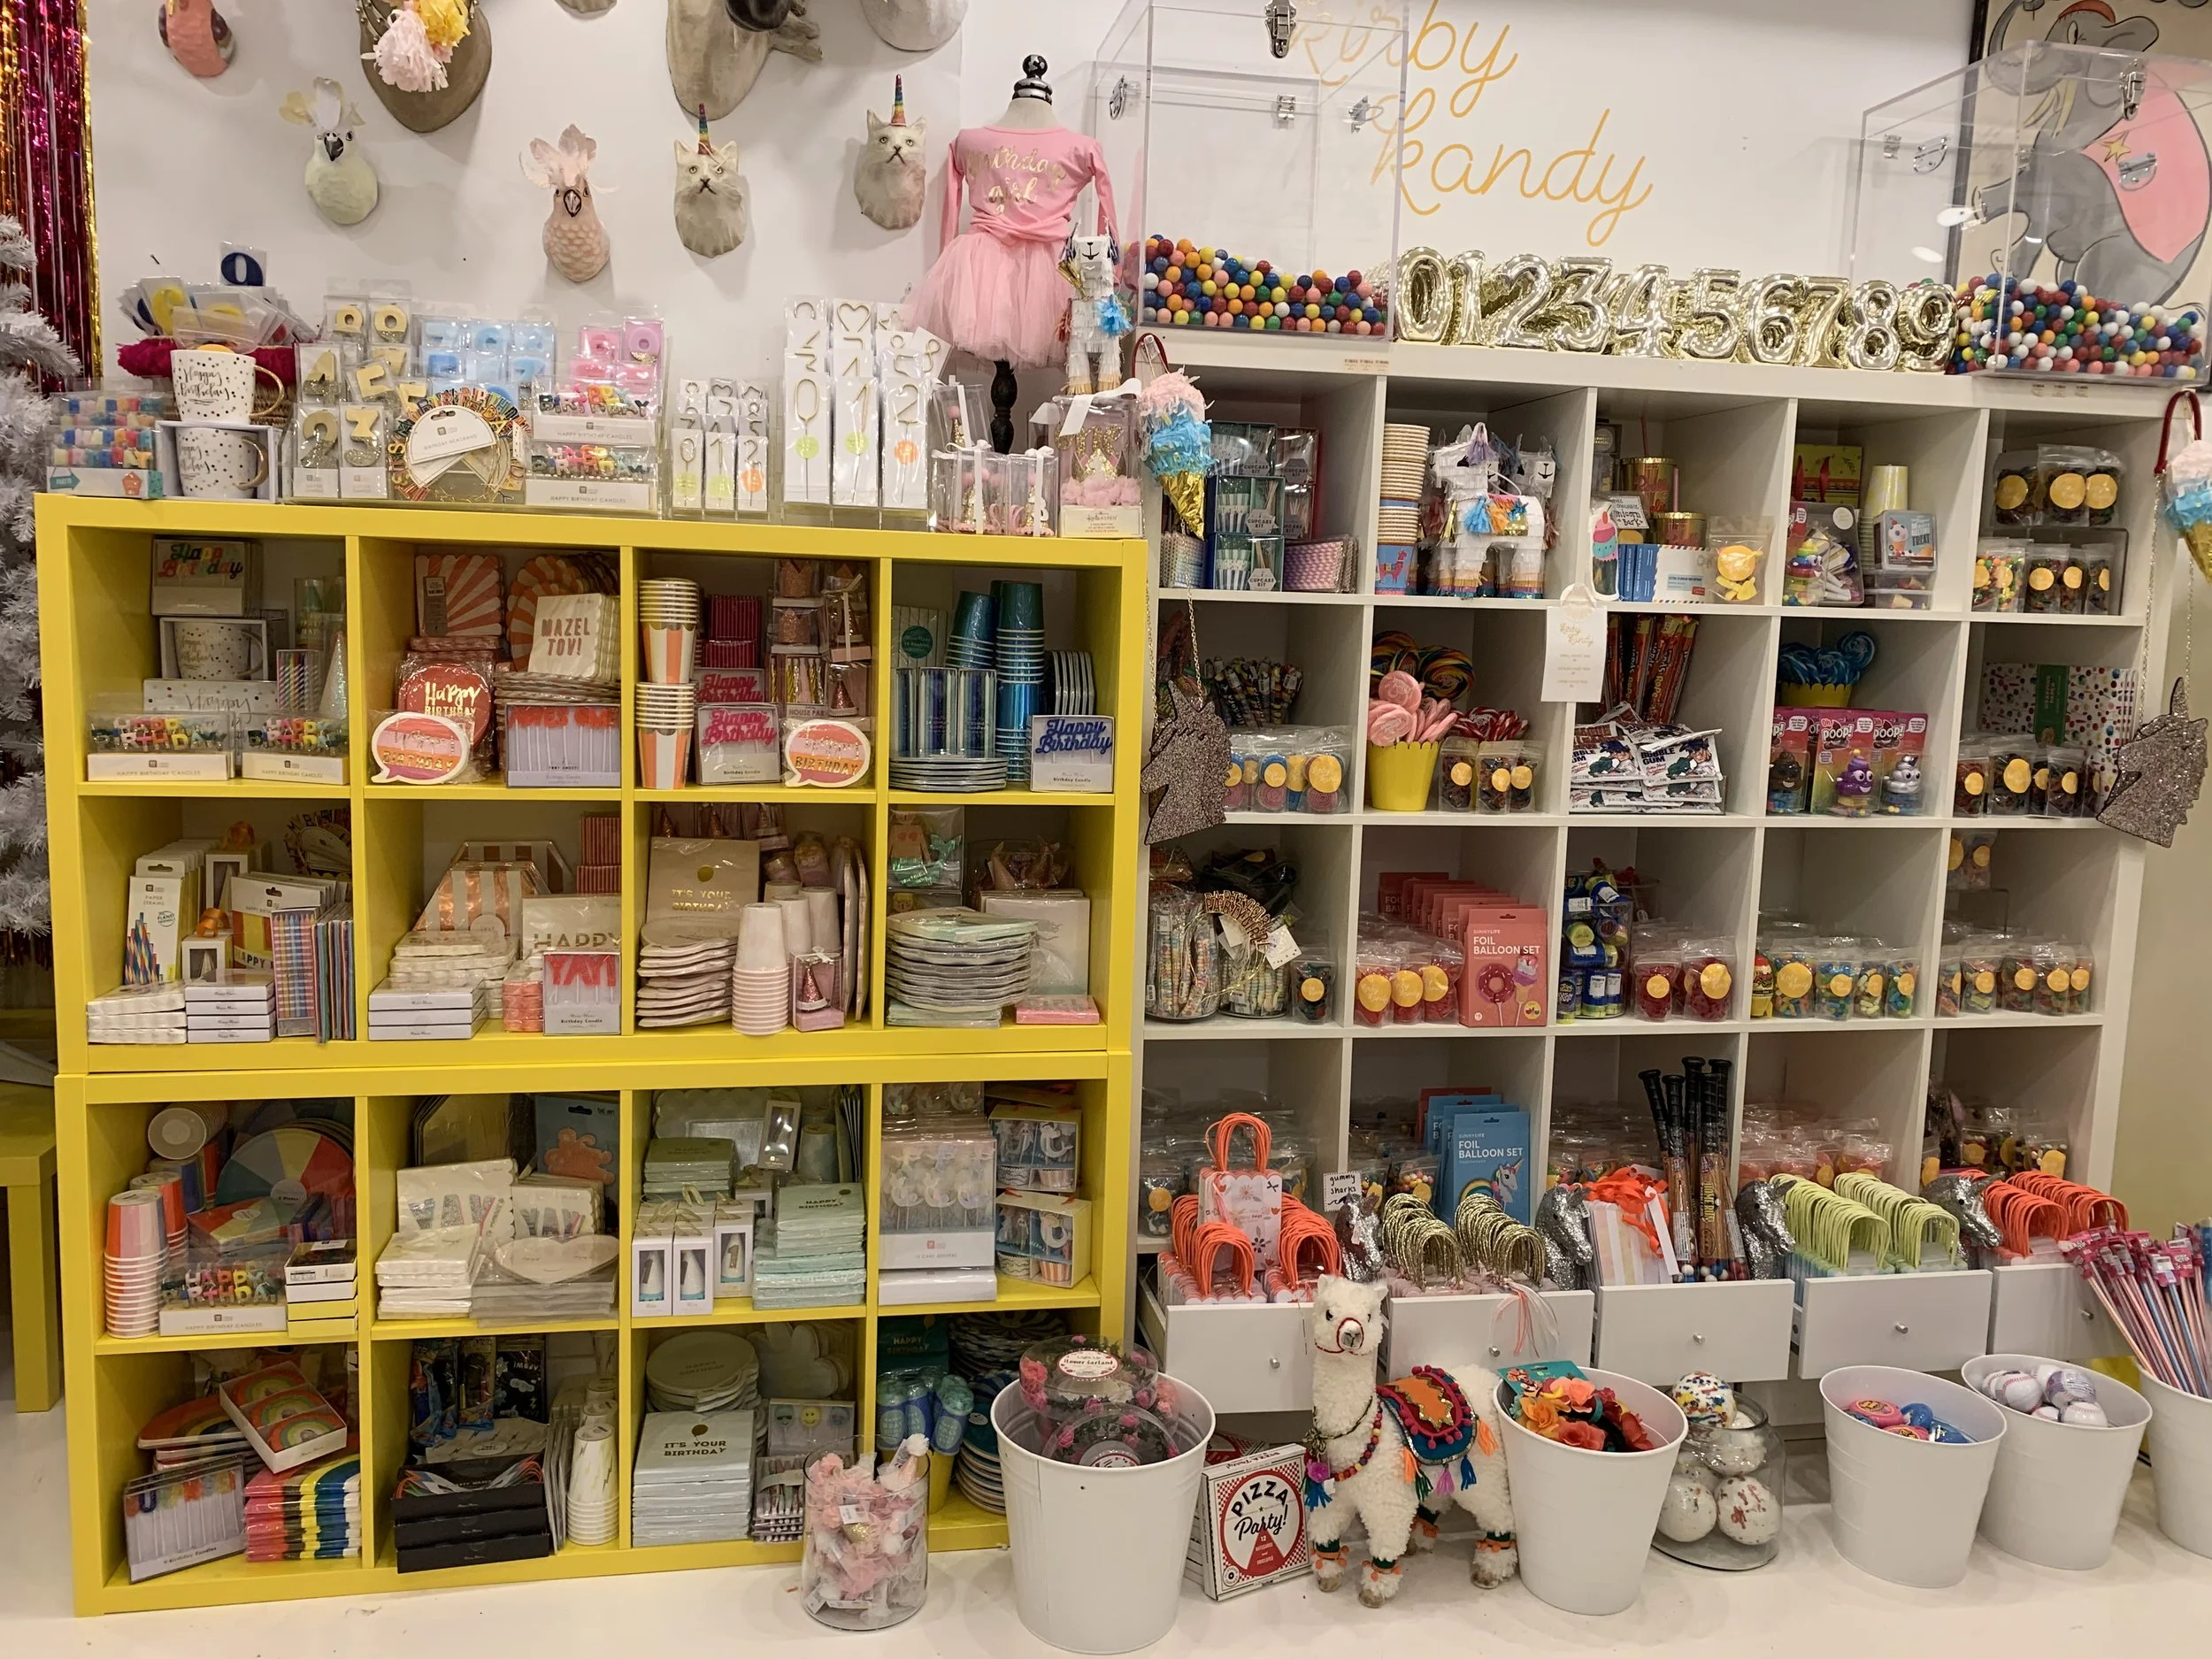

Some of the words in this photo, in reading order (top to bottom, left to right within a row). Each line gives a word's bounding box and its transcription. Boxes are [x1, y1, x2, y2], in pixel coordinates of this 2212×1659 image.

[541, 618, 591, 636] MAZEL
[547, 637, 582, 657] TOV!
[425, 680, 481, 708] Happy
[788, 708, 810, 717] HOUSE
[812, 708, 825, 717] PAR
[1046, 718, 1107, 738] Happy
[1822, 724, 1854, 741] POOP!
[1873, 723, 1905, 739] POOP!
[1035, 734, 1113, 755] Birthday
[1640, 747, 1676, 759] BUBBLE
[1642, 756, 1666, 765] GUM
[1385, 895, 1402, 904] FOI
[534, 933, 622, 949] HAPPY
[1473, 936, 1496, 945] FOIL
[1473, 946, 1521, 955] BALLOON
[1523, 945, 1541, 955] SET
[1458, 1141, 1480, 1149] FOIL
[1458, 1148, 1504, 1159] BALLOON
[1506, 1148, 1524, 1156] SET
[1329, 1174, 1356, 1187] gummy
[1330, 1186, 1356, 1194] sharks
[798, 1201, 844, 1210] BIRTHDAY
[893, 1336, 922, 1345] HAPPY
[664, 1447, 727, 1456] BIRTHDAY
[1231, 1479, 1289, 1517] PIZZA
[1233, 1503, 1289, 1541] Party!
